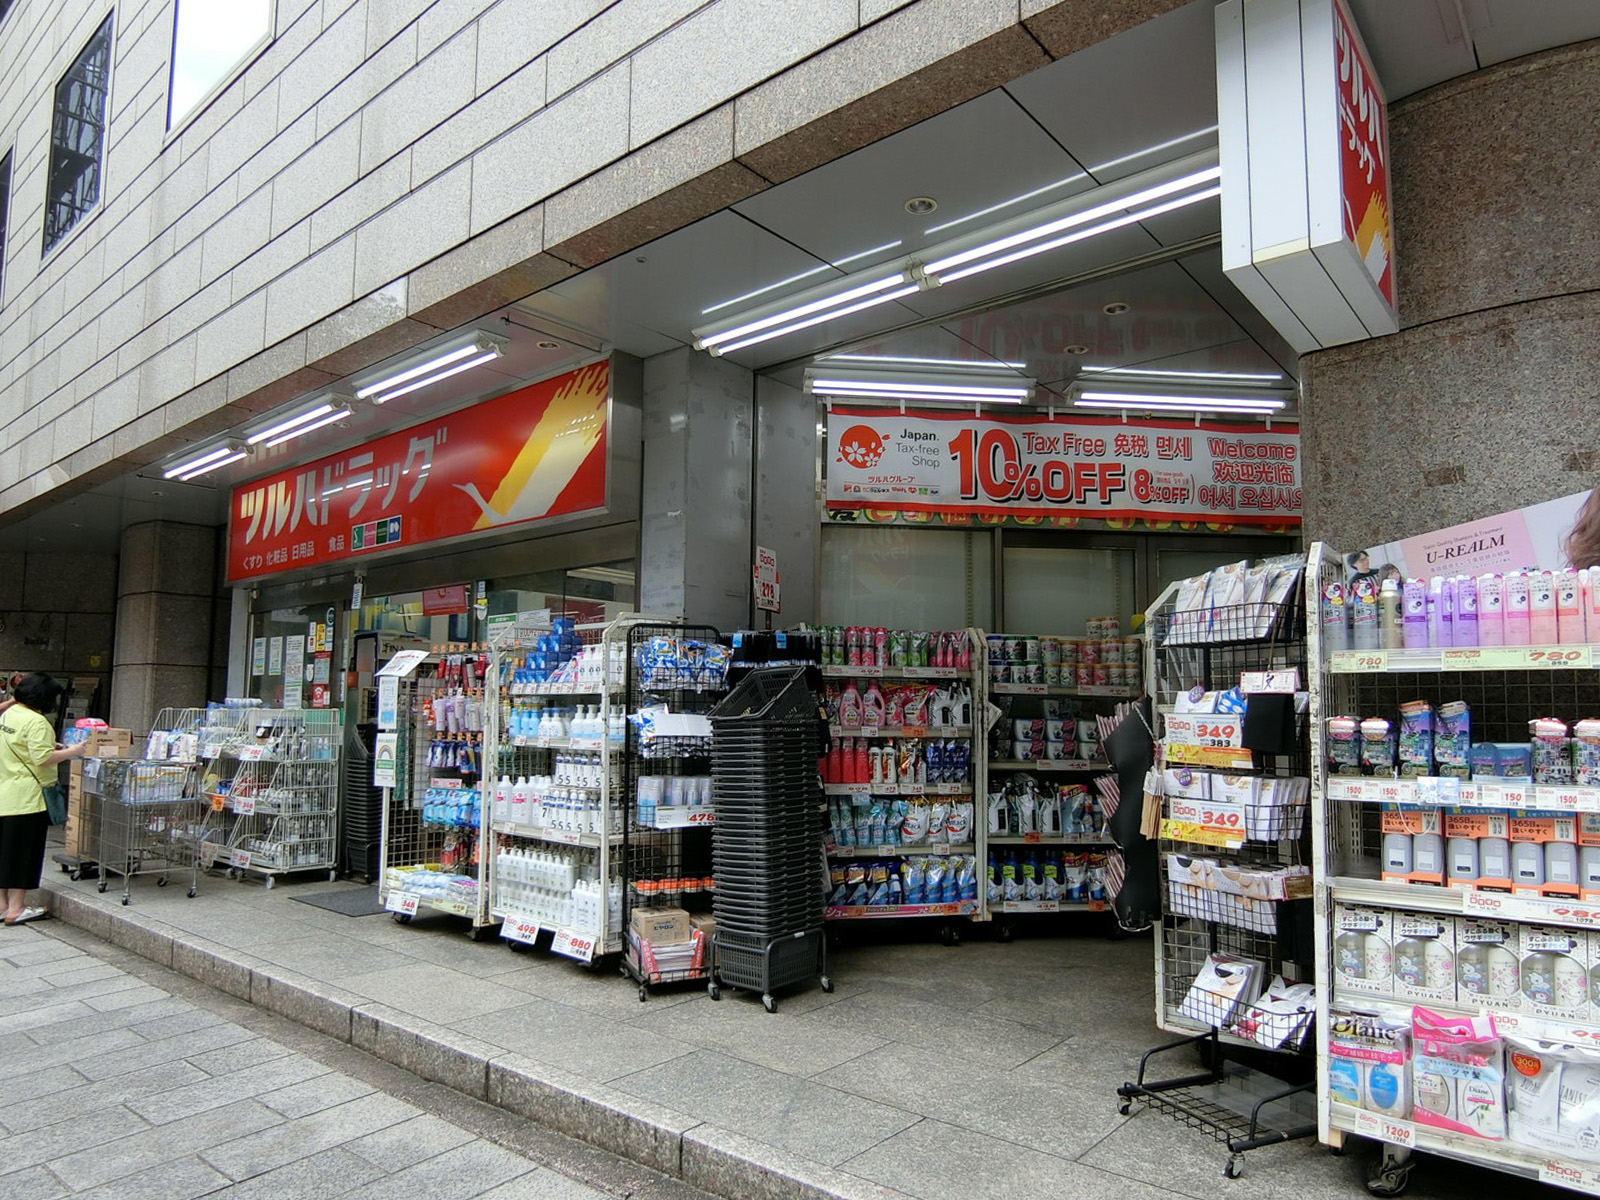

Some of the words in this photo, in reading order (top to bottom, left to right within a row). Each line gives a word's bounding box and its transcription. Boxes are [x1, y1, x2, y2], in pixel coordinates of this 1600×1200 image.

[900, 428, 940, 442] Japan.
[895, 442, 940, 456] Tax-free
[1022, 431, 1060, 454] Tax
[1063, 433, 1105, 456] Free
[1114, 433, 1149, 457] 免税
[1156, 437, 1192, 460] 면세
[1207, 437, 1296, 459] Welcome
[912, 456, 940, 469] Shop
[1213, 461, 1294, 485] 欢迎光临
[241, 426, 448, 545] ツルハドラッグ
[1199, 486, 1235, 509] 어서
[242, 555, 263, 569] くすり
[266, 547, 288, 565] 化粧品
[291, 541, 315, 560] 日用品
[328, 535, 345, 552] 食品
[1426, 534, 1506, 564] U-REALM
[1358, 657, 1382, 665] 780
[1529, 651, 1582, 660] 780
[1197, 724, 1235, 738] 349
[1210, 739, 1231, 747] 383
[1346, 786, 1361, 794] 1500
[1505, 793, 1521, 801] 150
[1559, 795, 1577, 804] 1500
[1202, 811, 1240, 827] 349
[517, 923, 536, 935] 498
[570, 938, 591, 950] 880
[1347, 981, 1380, 991] PYUAN
[1407, 989, 1442, 1000] PYUAN
[1472, 997, 1509, 1008] PYUAN
[1535, 1007, 1575, 1019] PYUAN
[1385, 1125, 1410, 1138] 1200
